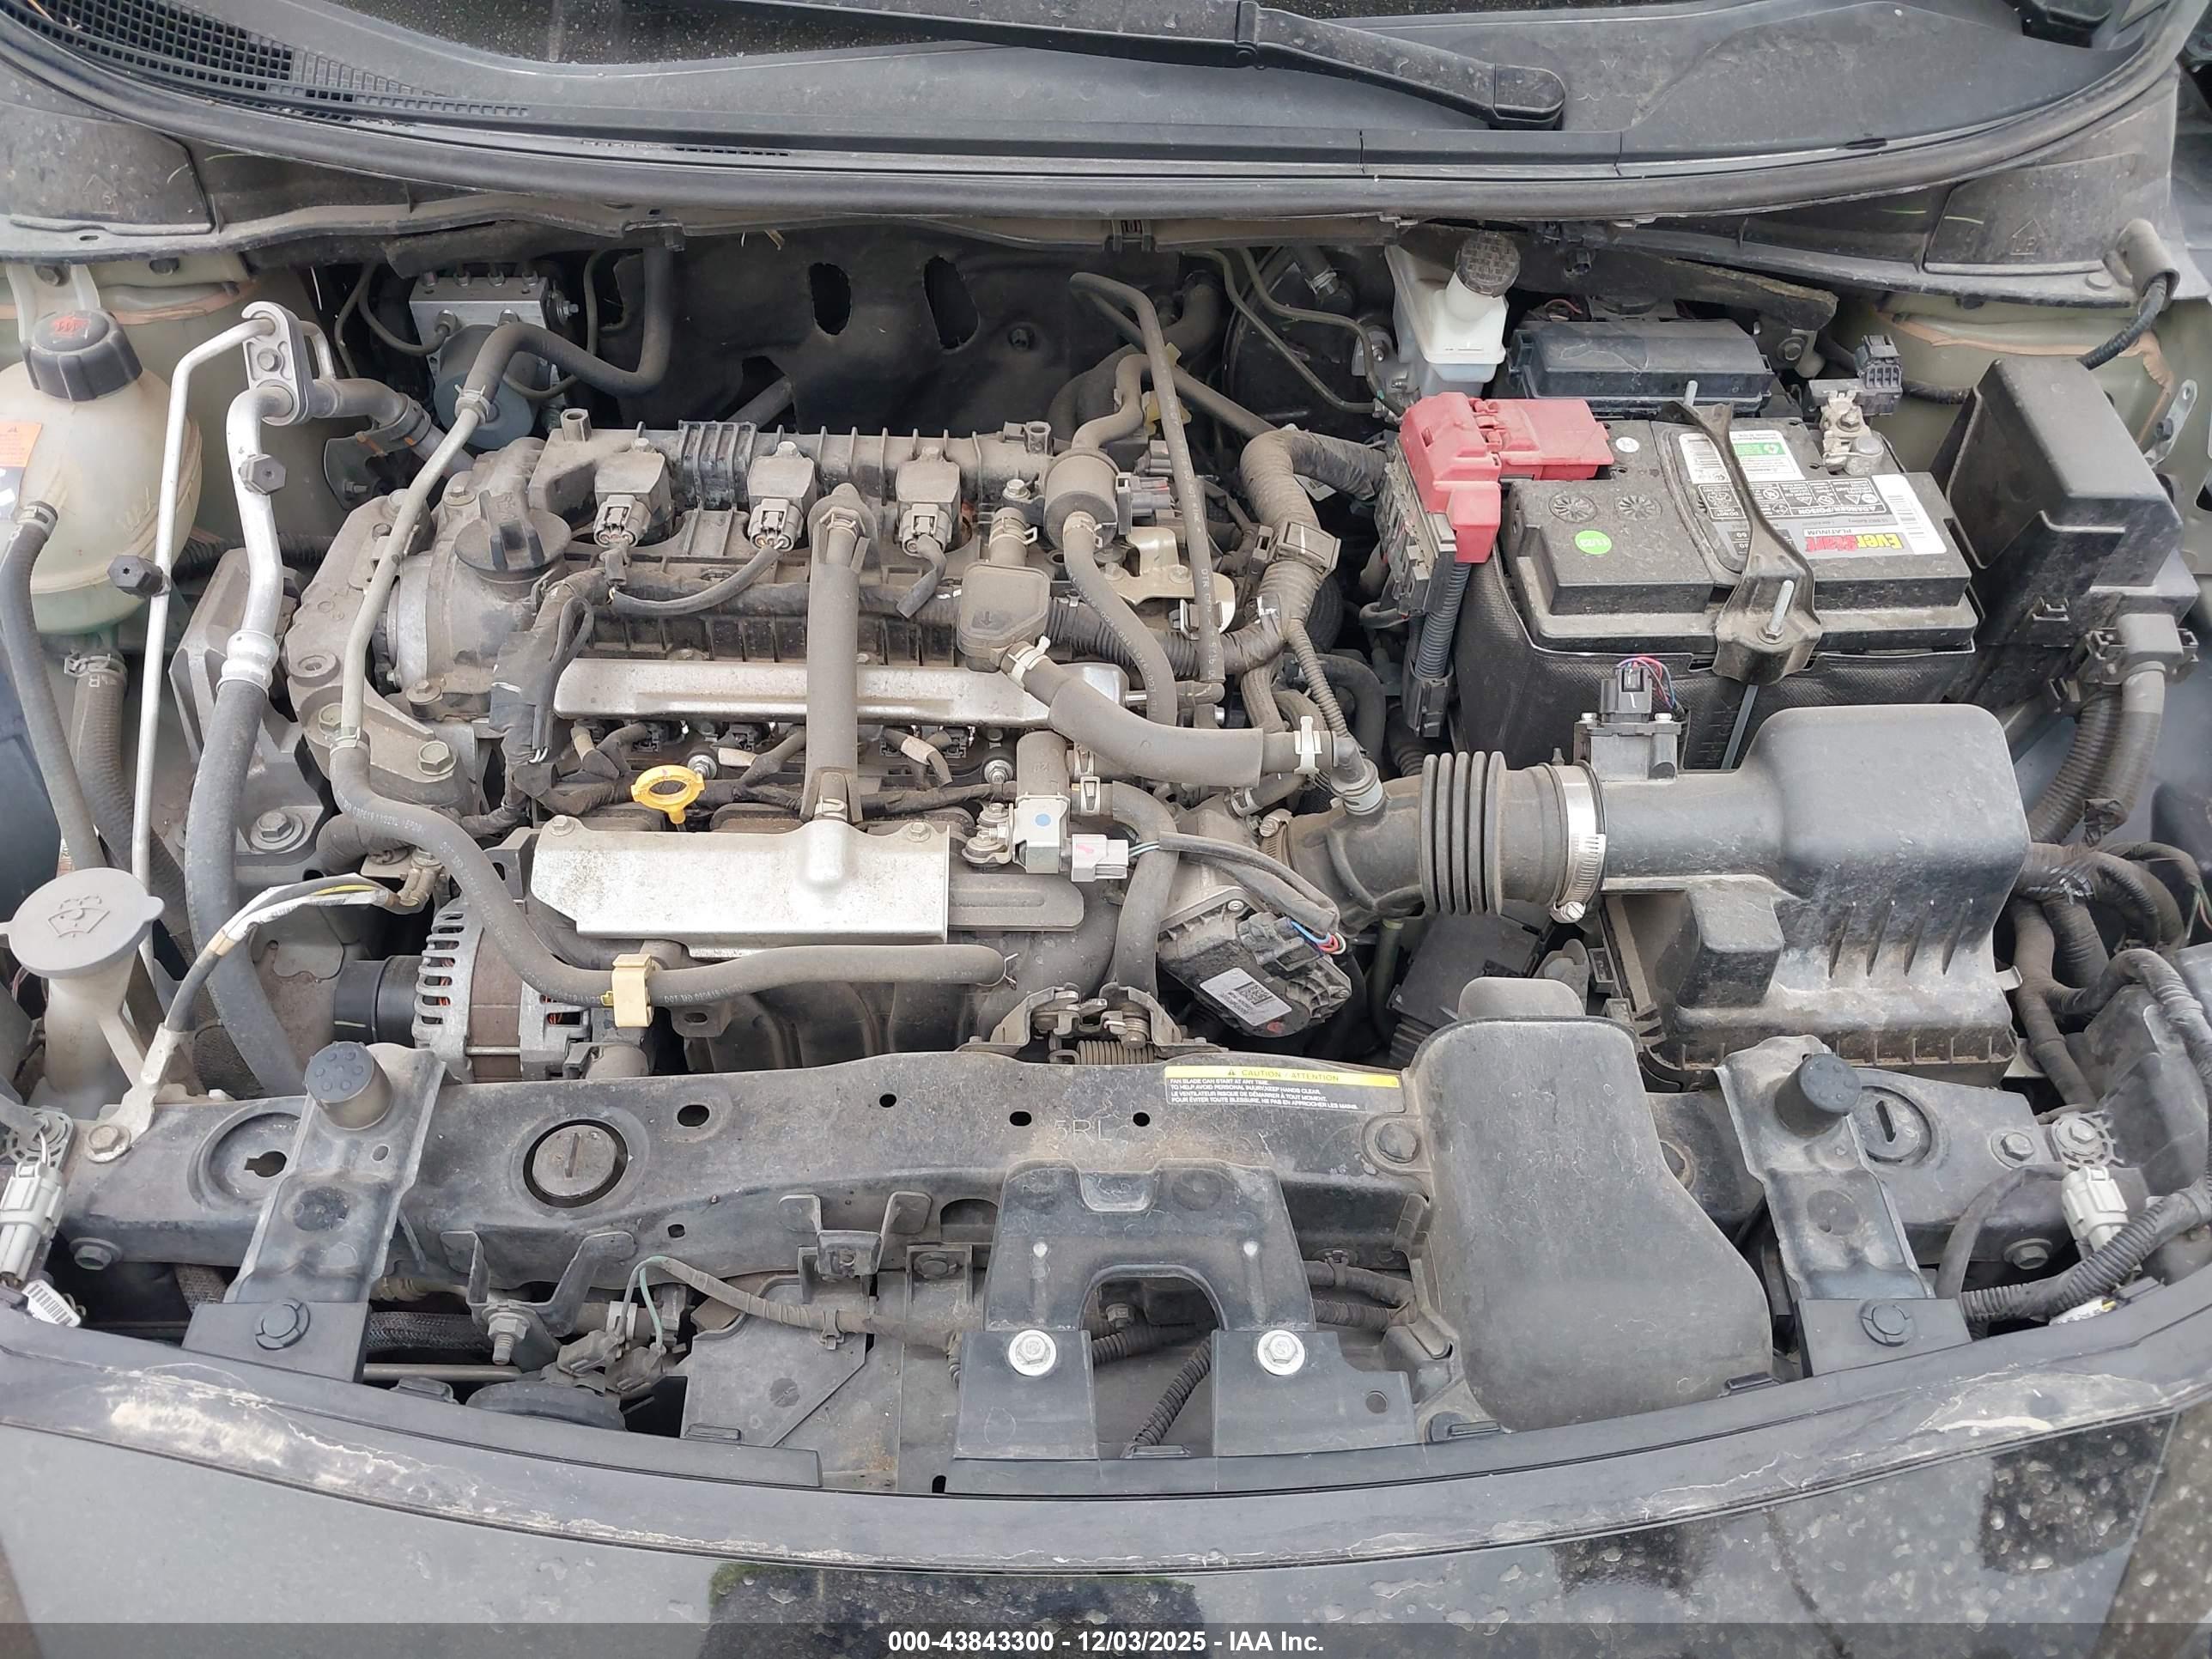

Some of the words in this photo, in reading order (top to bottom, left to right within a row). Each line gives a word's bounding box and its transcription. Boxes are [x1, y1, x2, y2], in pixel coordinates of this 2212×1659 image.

[1805, 532, 1905, 552] EverStart
[1242, 1069, 1281, 1078] CAUTION
[1291, 1073, 1339, 1081] ATTENTION
